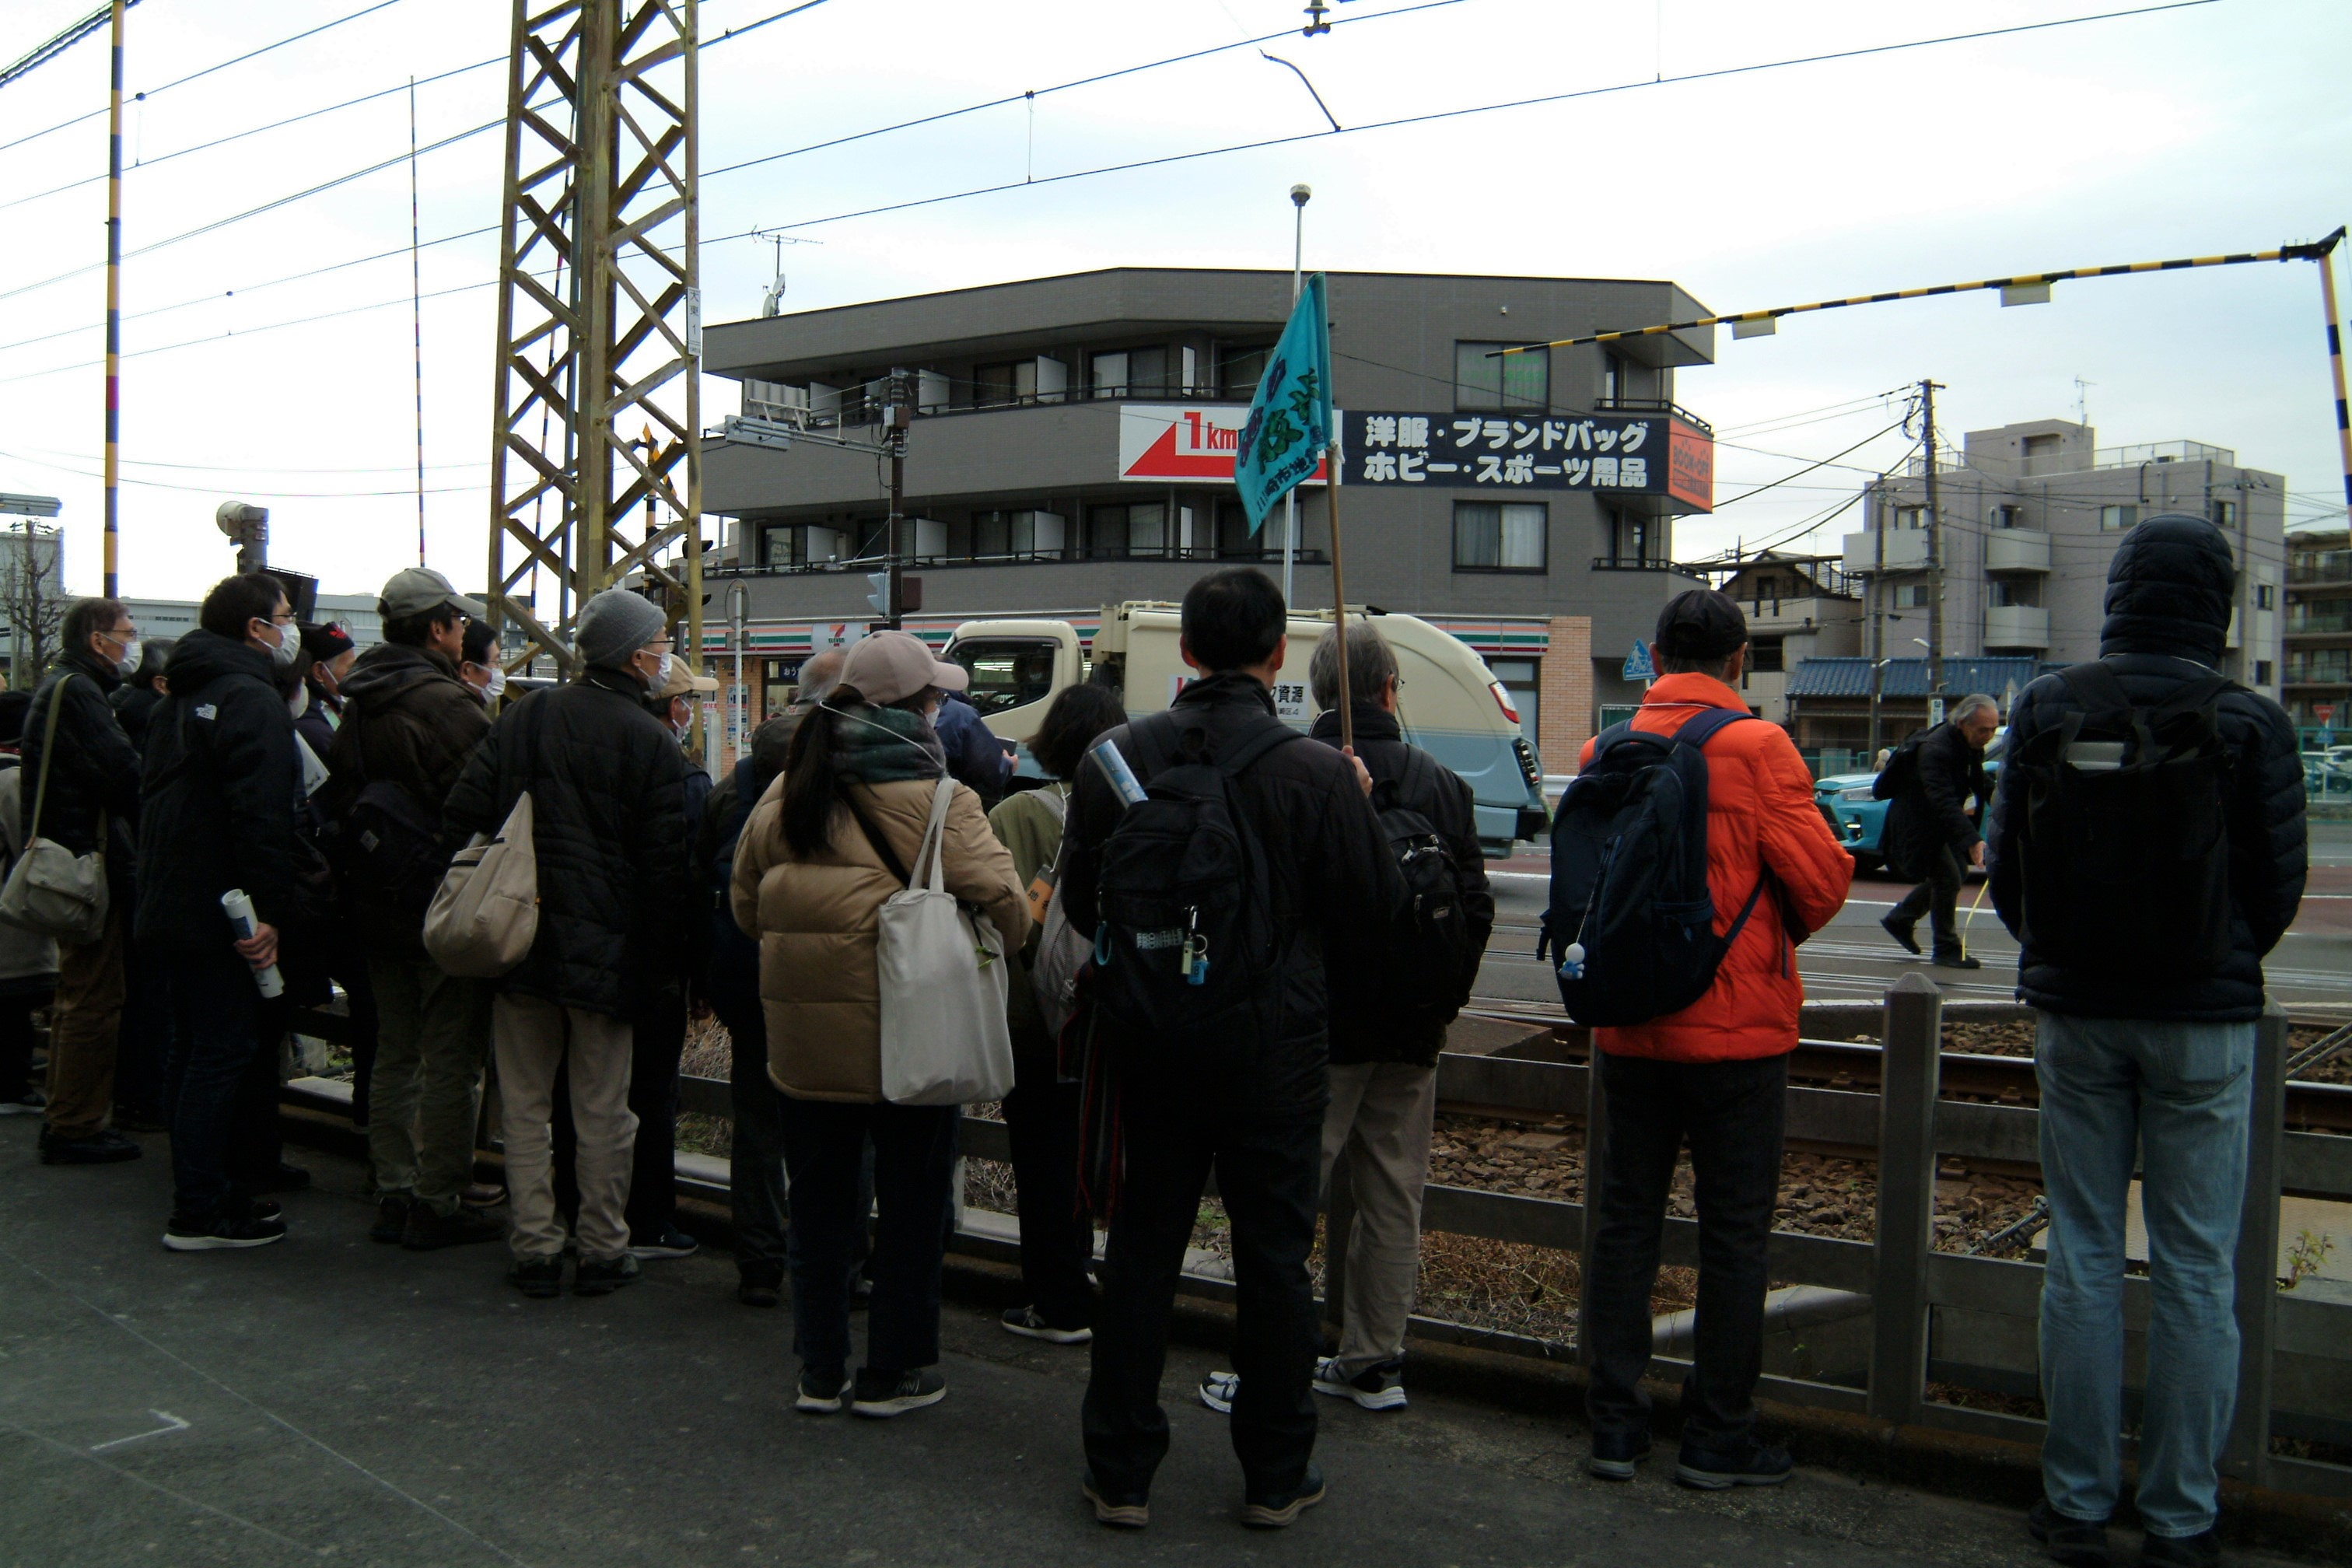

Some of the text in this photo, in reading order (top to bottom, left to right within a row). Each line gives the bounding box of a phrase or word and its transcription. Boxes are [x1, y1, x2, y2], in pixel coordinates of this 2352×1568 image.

[1365, 415, 1649, 453] 洋服・ブランドバッグ
[1363, 450, 1647, 488] ホビー・スポーツ用品
